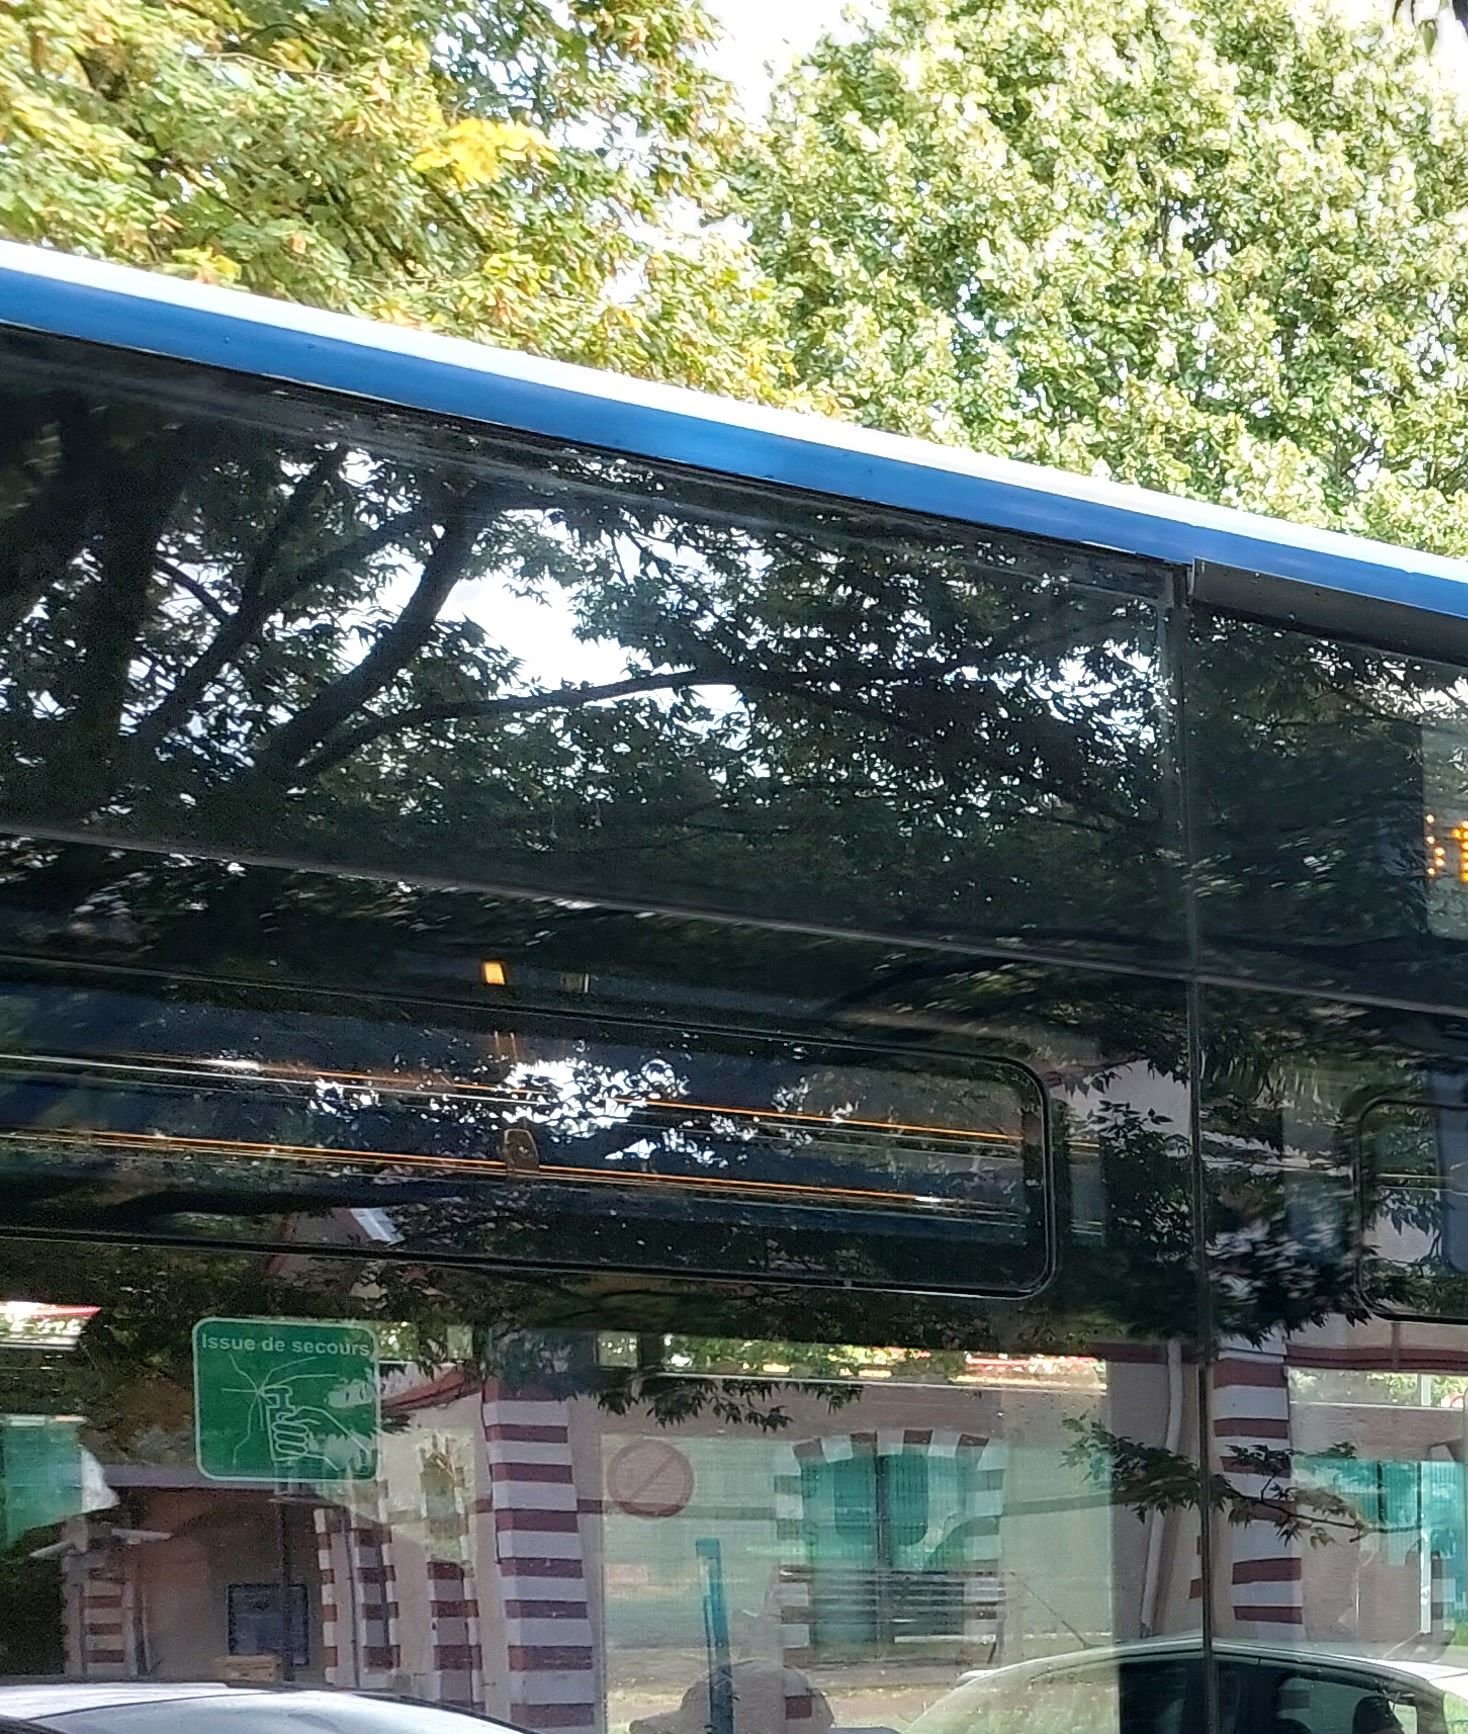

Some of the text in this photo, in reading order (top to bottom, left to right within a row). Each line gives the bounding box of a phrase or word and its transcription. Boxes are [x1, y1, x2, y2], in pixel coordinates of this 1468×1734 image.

[202, 1333, 371, 1357] Issue de secours
